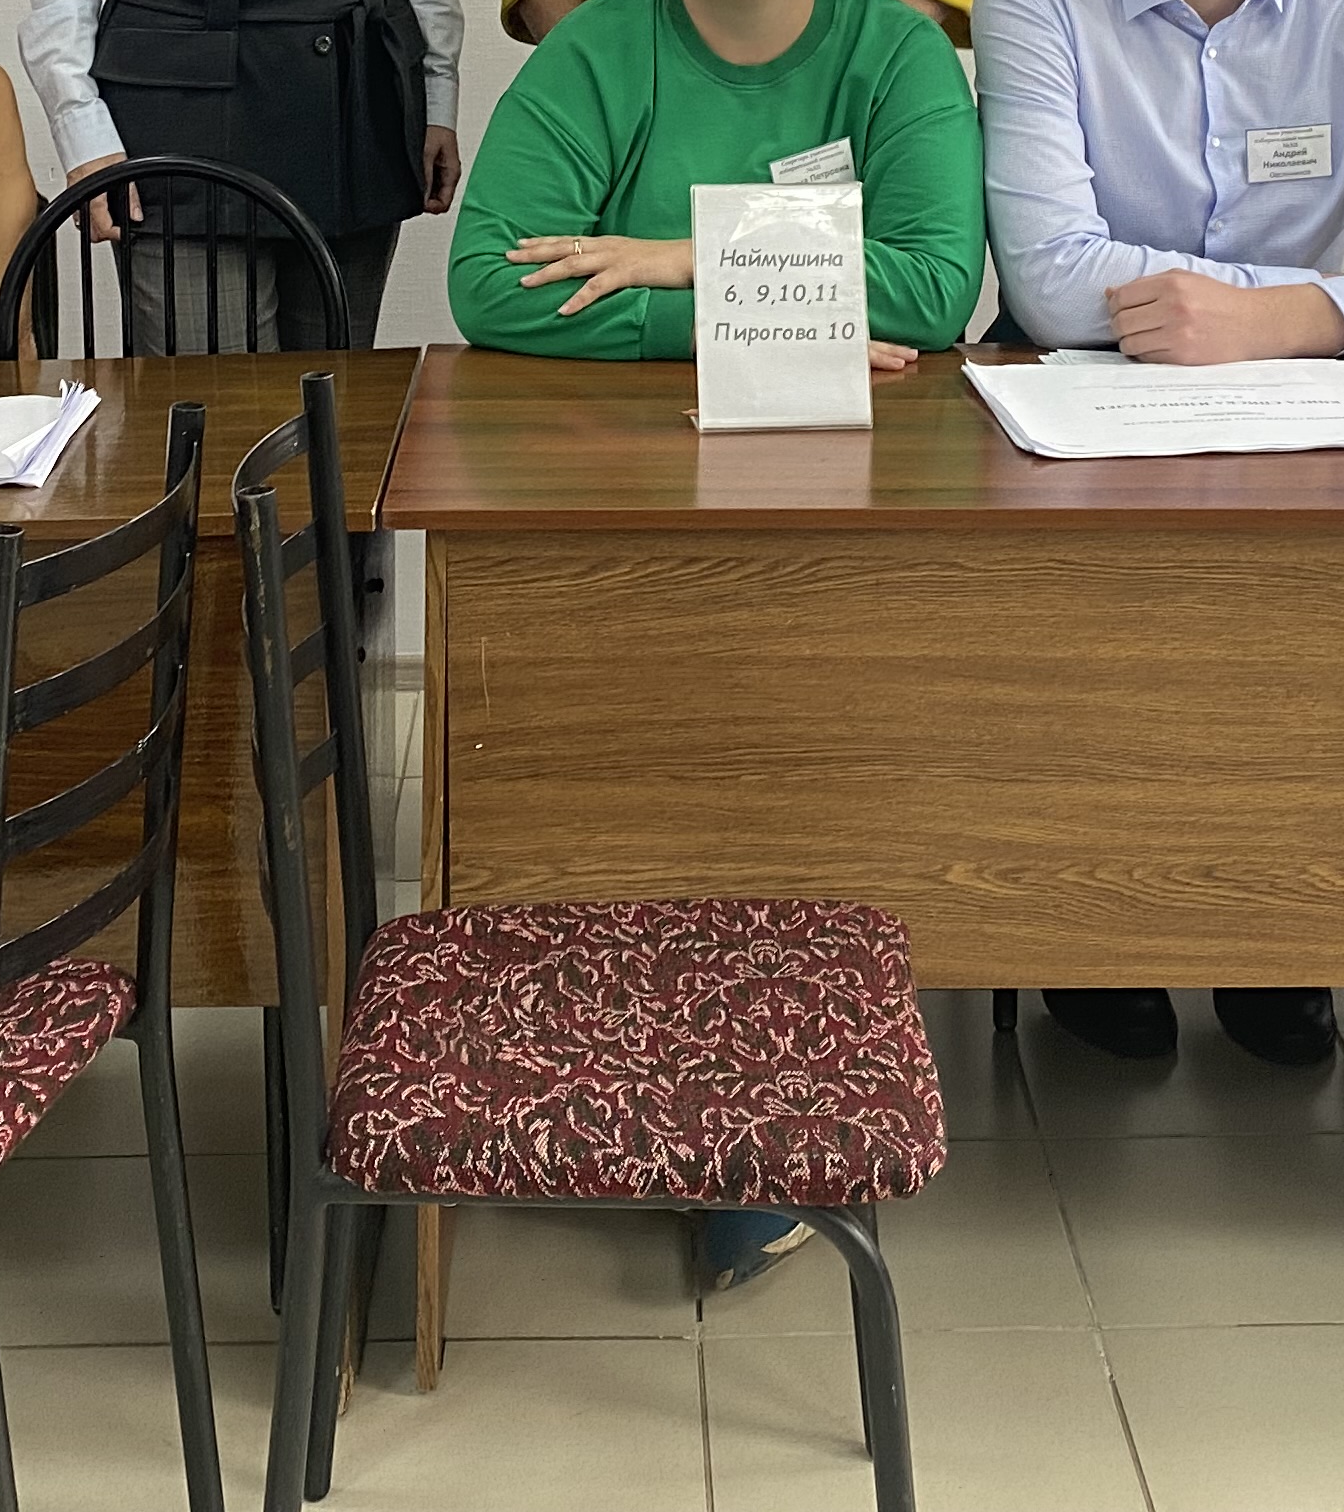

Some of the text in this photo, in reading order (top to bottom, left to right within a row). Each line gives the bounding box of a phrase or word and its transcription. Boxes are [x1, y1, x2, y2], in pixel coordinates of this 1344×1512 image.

[1263, 158, 1317, 170] Николаевич
[1273, 148, 1308, 159] Андрей
[719, 248, 844, 272] Наймушина
[724, 284, 743, 306] 6,
[714, 321, 856, 346] Пирогова 10
